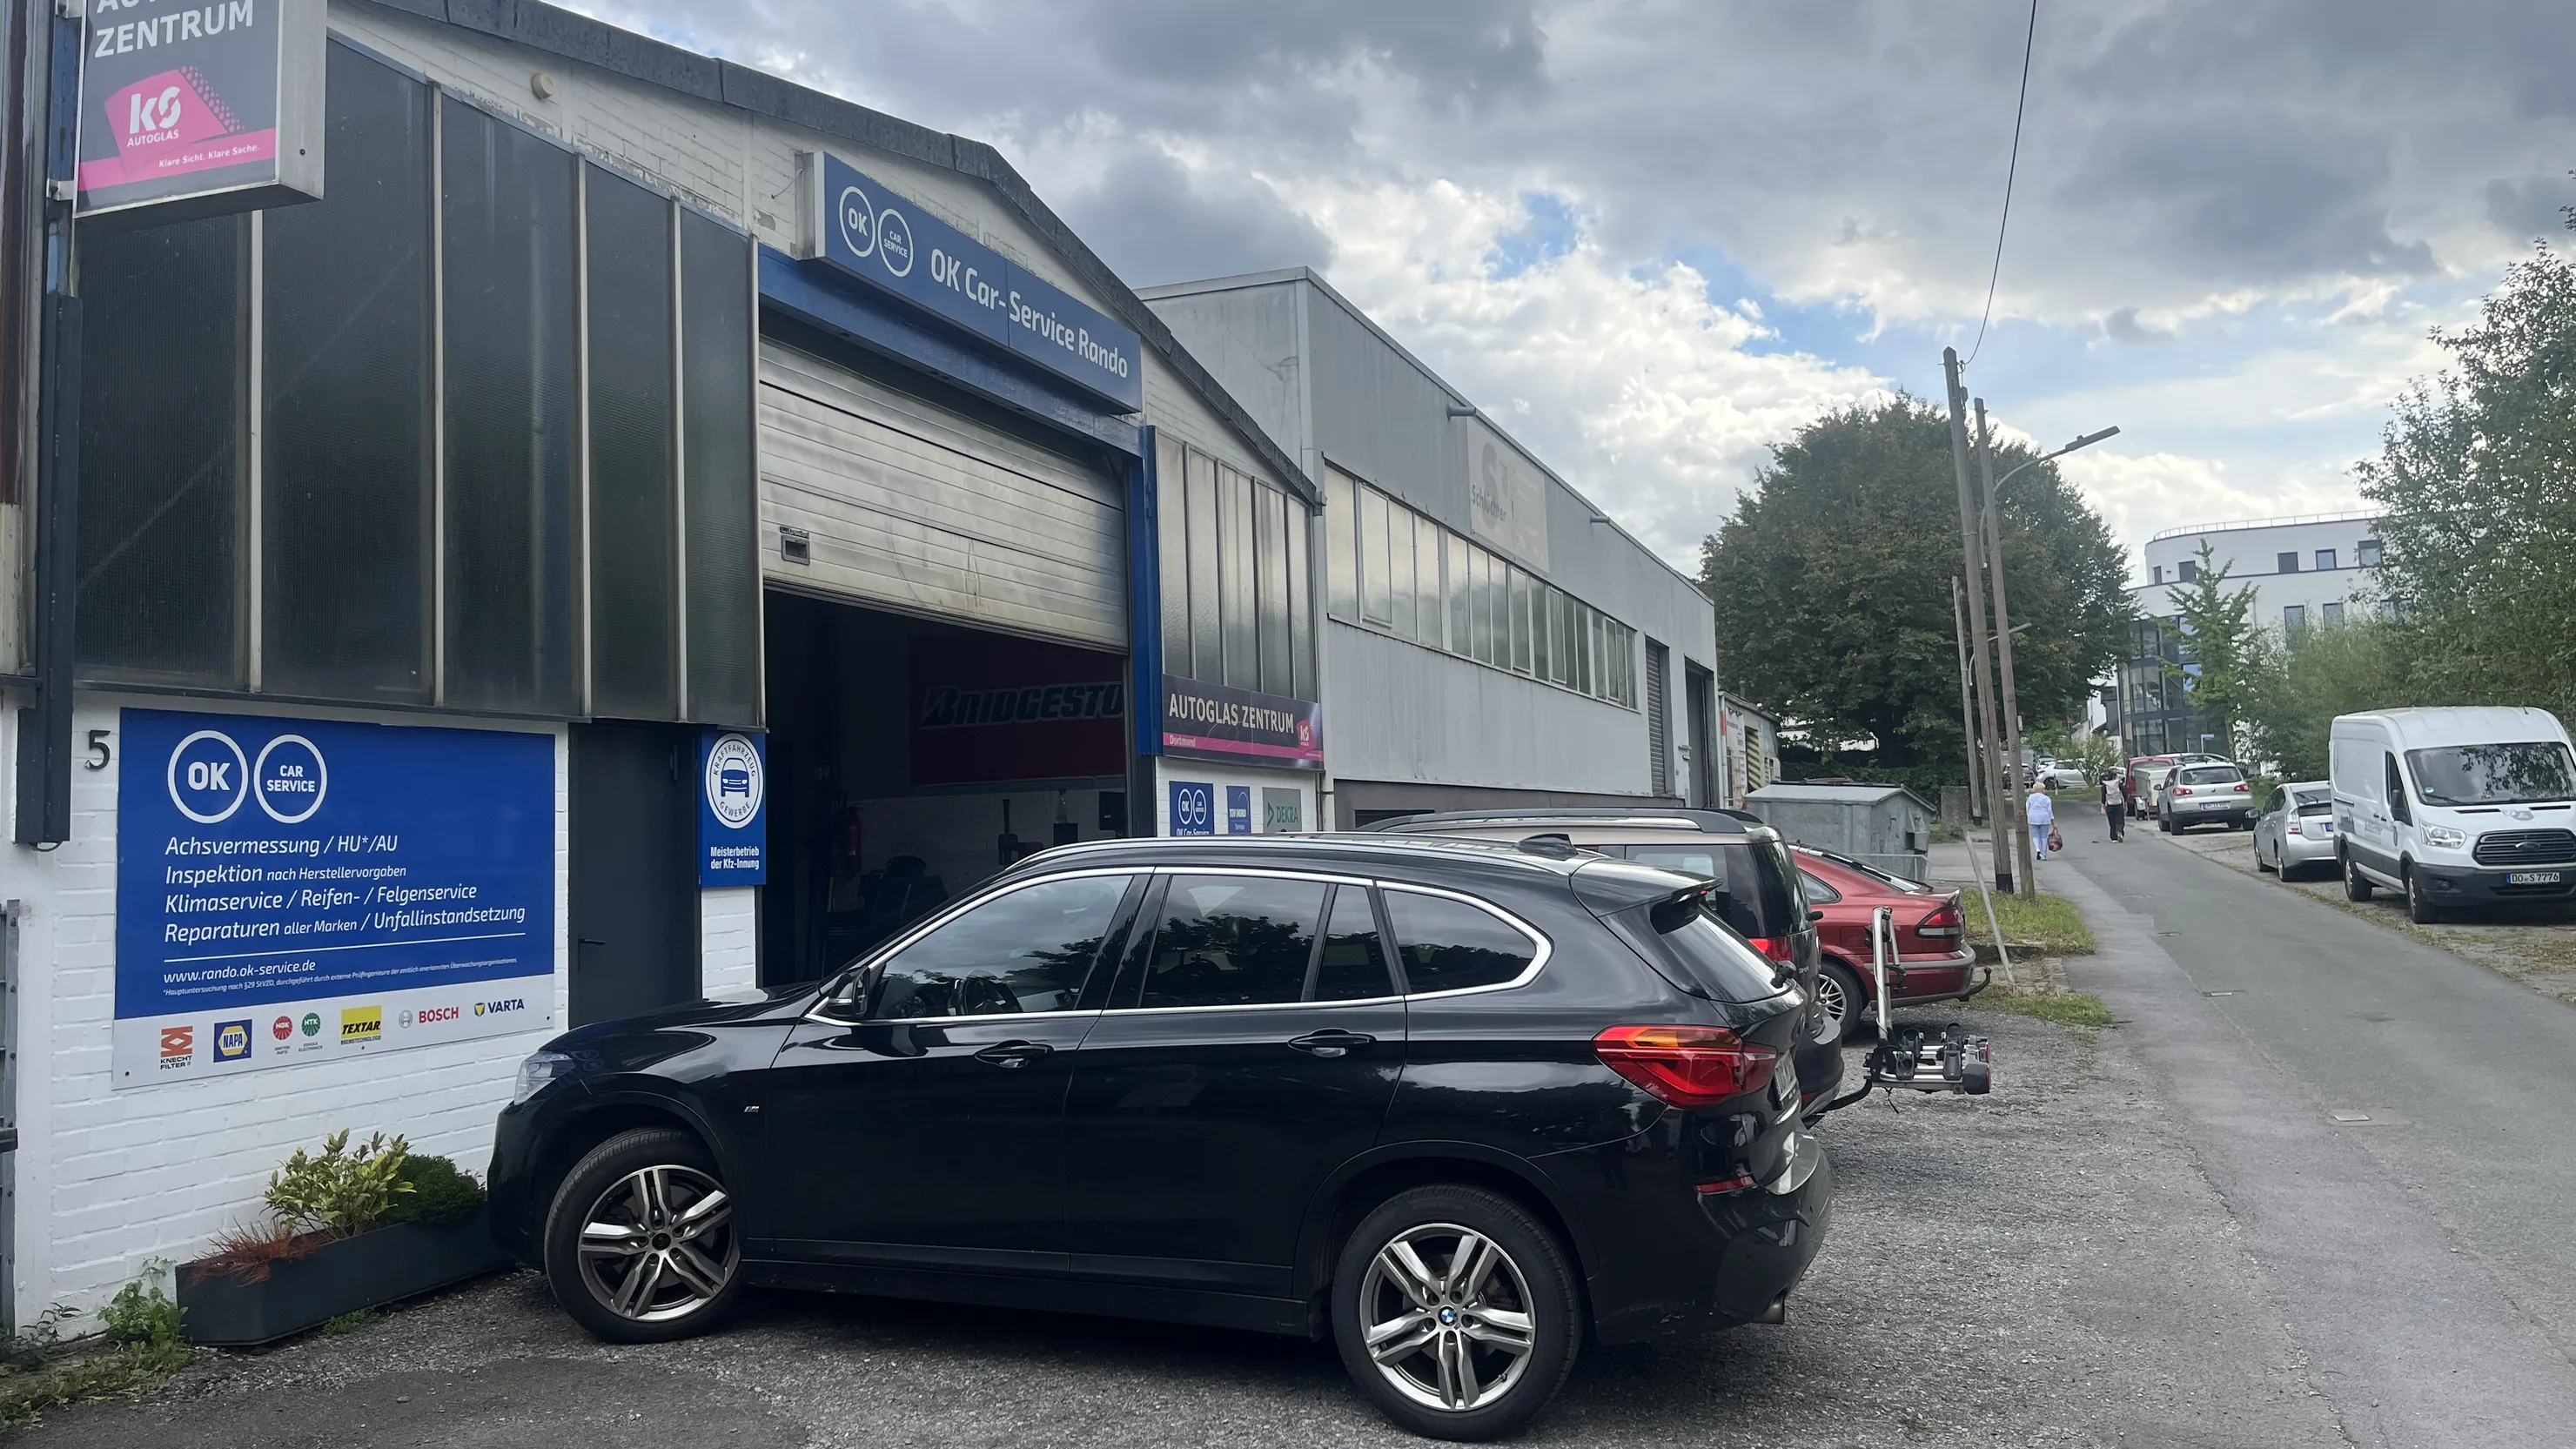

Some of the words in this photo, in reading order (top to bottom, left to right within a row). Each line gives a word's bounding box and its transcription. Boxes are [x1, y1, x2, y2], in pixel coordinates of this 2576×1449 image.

[95, 0, 253, 57] ZENTRUM
[127, 130, 179, 147] AUTOGLAS
[158, 158, 180, 168] Klare
[183, 153, 205, 164] Sicht.
[208, 148, 230, 160] Klare
[231, 144, 259, 156] Sache.
[848, 207, 868, 238] OK
[889, 230, 902, 245] CAR
[883, 238, 908, 258] SERVICE
[930, 248, 961, 292] OK
[965, 271, 1075, 351] Car-Service
[1078, 326, 1128, 379] Rando
[1169, 694, 1238, 727] AUTOGLAS
[1241, 705, 1294, 734] ZENTRUM
[84, 730, 111, 770] 5
[1170, 735, 1196, 748] Dortmund
[713, 743, 756, 777] KRAFTFAHRZEUG
[187, 761, 231, 791] OK
[279, 765, 303, 778] CAR
[266, 779, 315, 793] SERVICE
[720, 801, 750, 818] GEWERBE
[1181, 801, 1190, 812] OK
[1277, 806, 1298, 823] DEKRA
[164, 836, 320, 857] Achsvermessung
[710, 845, 760, 857] Meisterbetrieb
[710, 859, 722, 869] der
[723, 858, 760, 870] Kfz-Innung
[165, 864, 261, 888] Inspektion
[266, 868, 296, 881] nach
[299, 865, 406, 881] Herstellervorgaben
[2538, 873, 2559, 882] 7776
[164, 891, 283, 914] Klimaservice
[301, 888, 360, 910] Reifen-
[377, 883, 477, 906] Felgenservice
[164, 921, 279, 946] Reparaturen
[284, 922, 312, 935] aller
[313, 919, 358, 933] Marken
[374, 907, 526, 932] Unfallinstandsetzung
[164, 959, 316, 983] www.rando.ok-service.de
[244, 981, 255, 990] §29
[276, 976, 313, 985] durchgeführt
[419, 1006, 459, 1023] BOSCH
[487, 998, 525, 1014] VARTA
[341, 1020, 380, 1035] TEXTAR
[223, 1033, 244, 1049] NAPA
[340, 1035, 381, 1045] BREMSTECHNOLOGIE
[160, 1055, 192, 1064] KNECHT
[160, 1062, 185, 1070] FILTER
